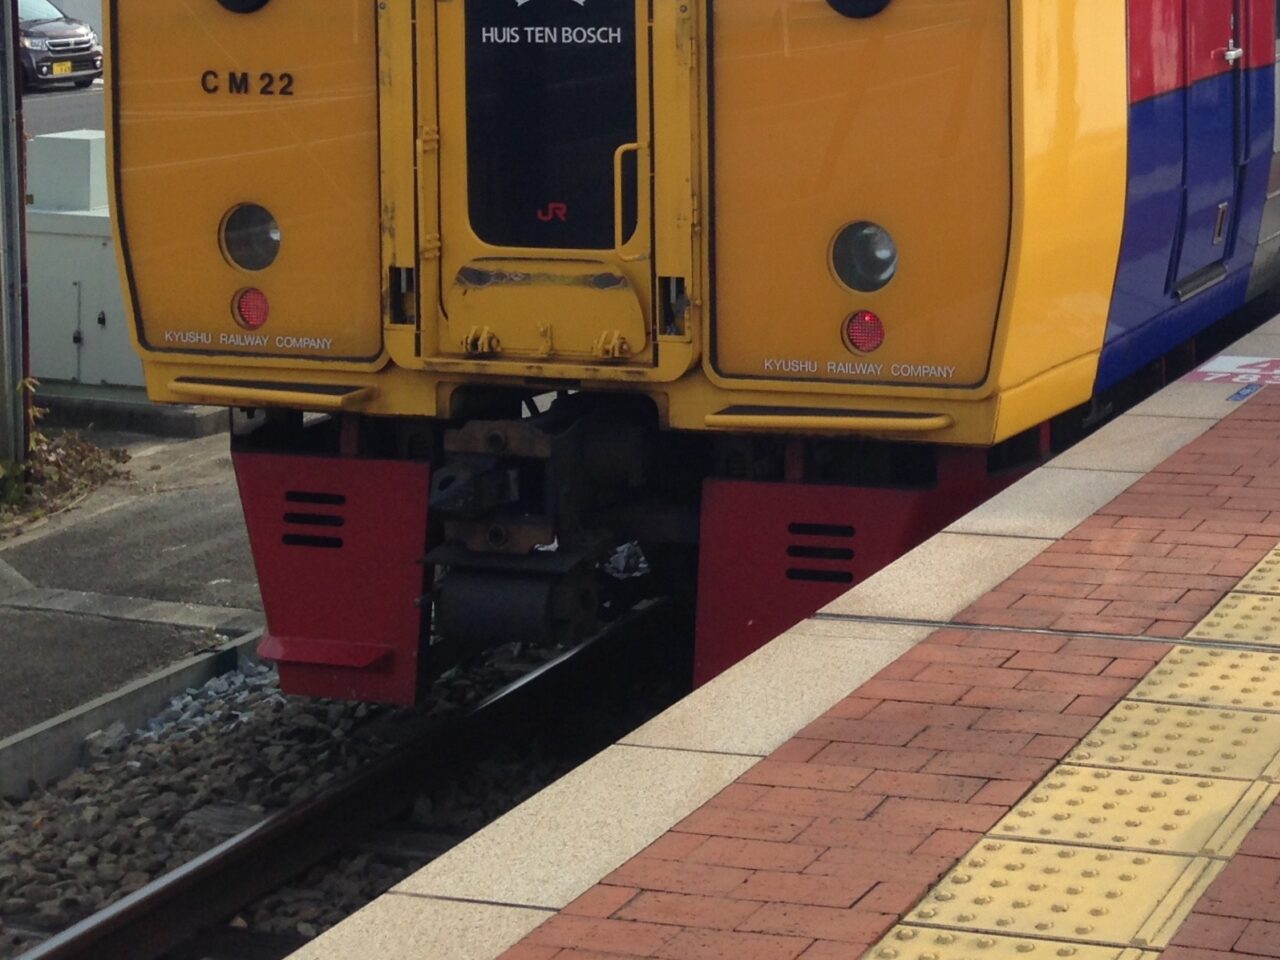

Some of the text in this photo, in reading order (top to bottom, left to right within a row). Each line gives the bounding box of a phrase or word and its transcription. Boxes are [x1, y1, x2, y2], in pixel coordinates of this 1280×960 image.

[482, 27, 621, 44] HUIS TEN BOSCH
[537, 202, 567, 221] JR
[165, 331, 332, 349] KYUSHU RAILWAY COMPANY
[764, 359, 956, 378] KYUSHU RAILWAY COMPANY
